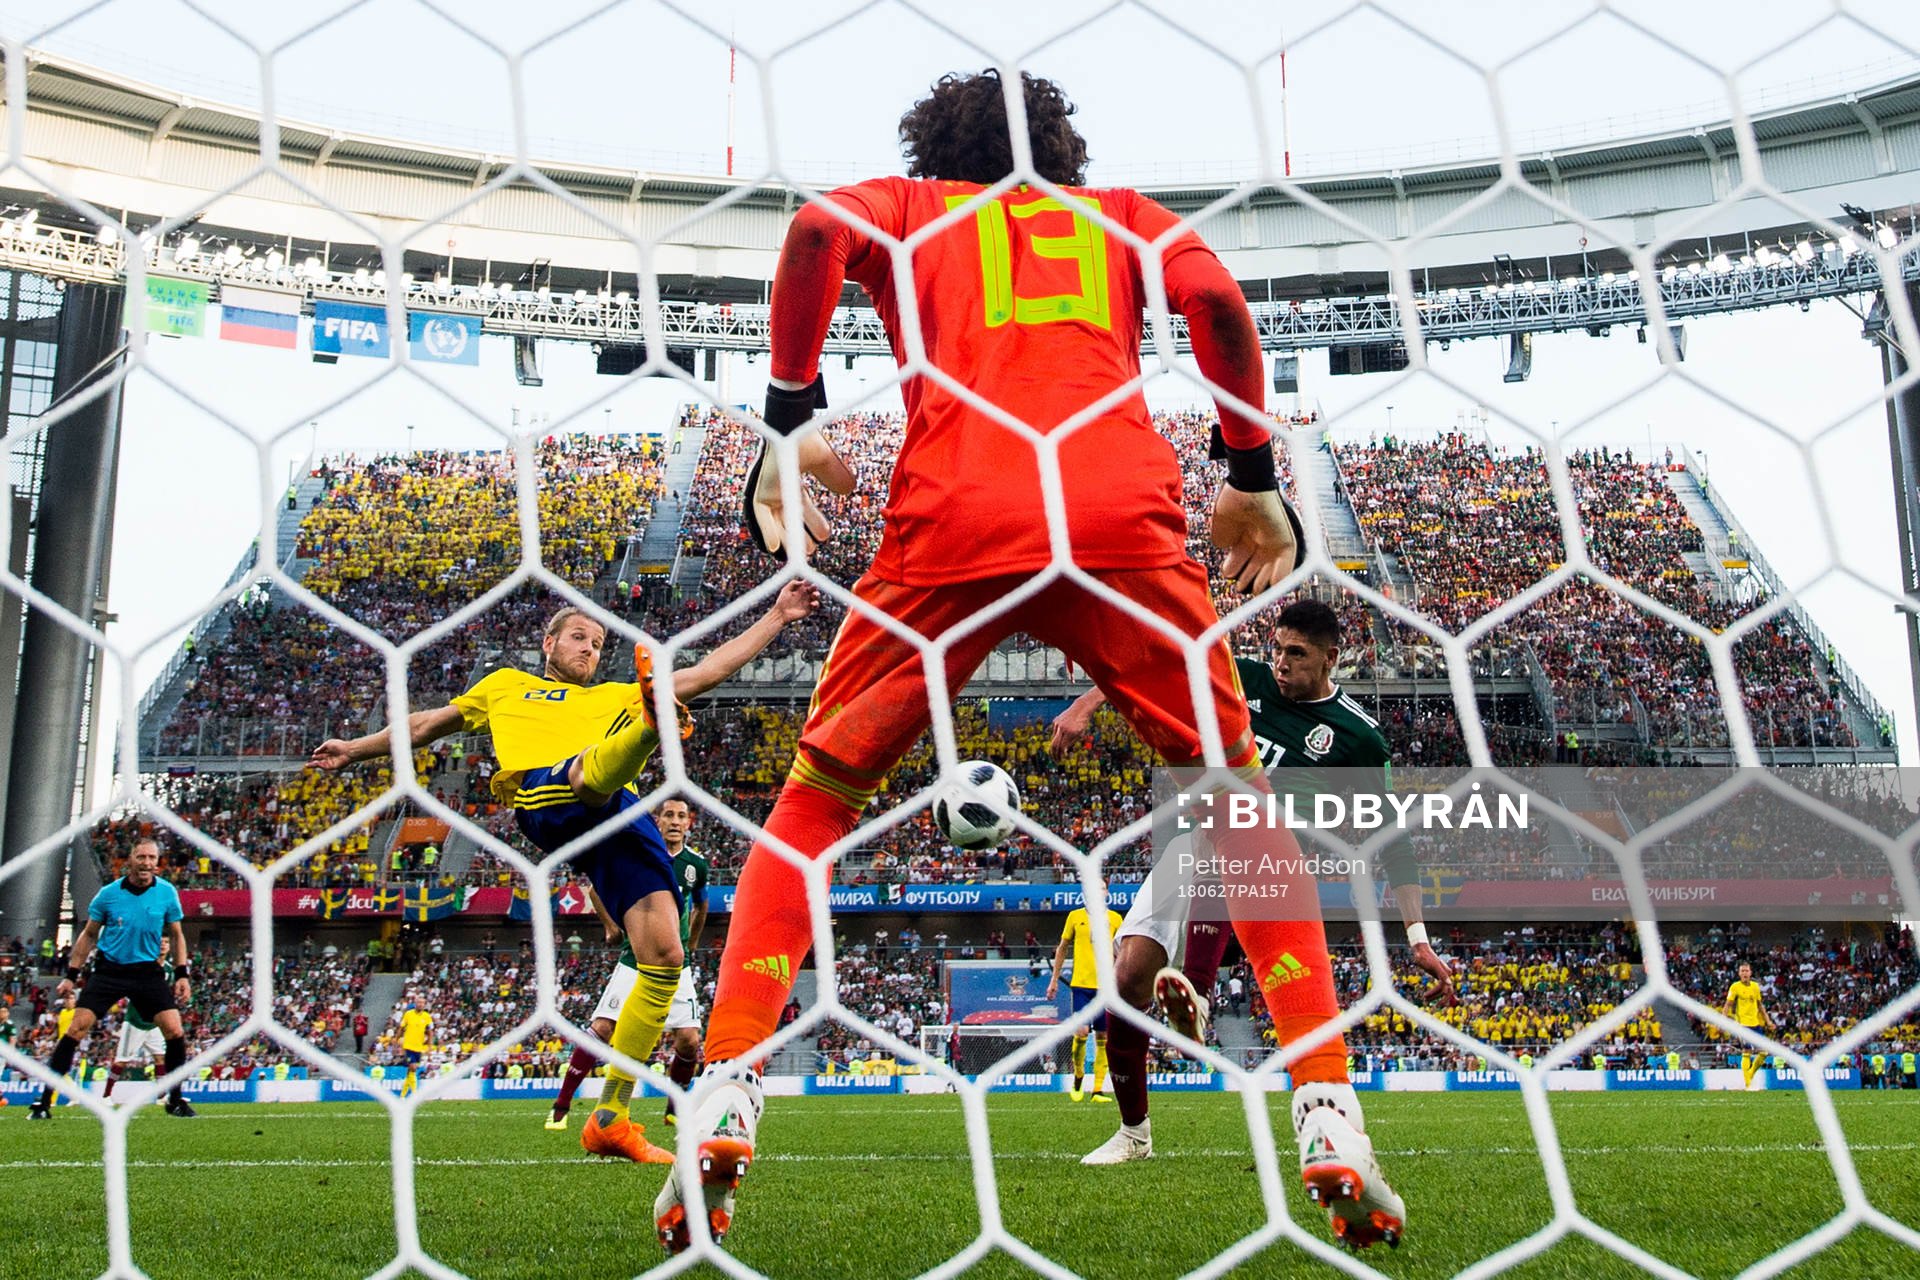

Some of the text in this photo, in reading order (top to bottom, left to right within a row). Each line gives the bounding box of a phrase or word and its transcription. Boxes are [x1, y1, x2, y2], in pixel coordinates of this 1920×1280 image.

[944, 195, 1111, 331] 13
[324, 317, 380, 342] FIFA
[905, 890, 981, 905] ФУТБОЛУ
[742, 961, 791, 989] adidas
[1264, 966, 1312, 993] adidas
